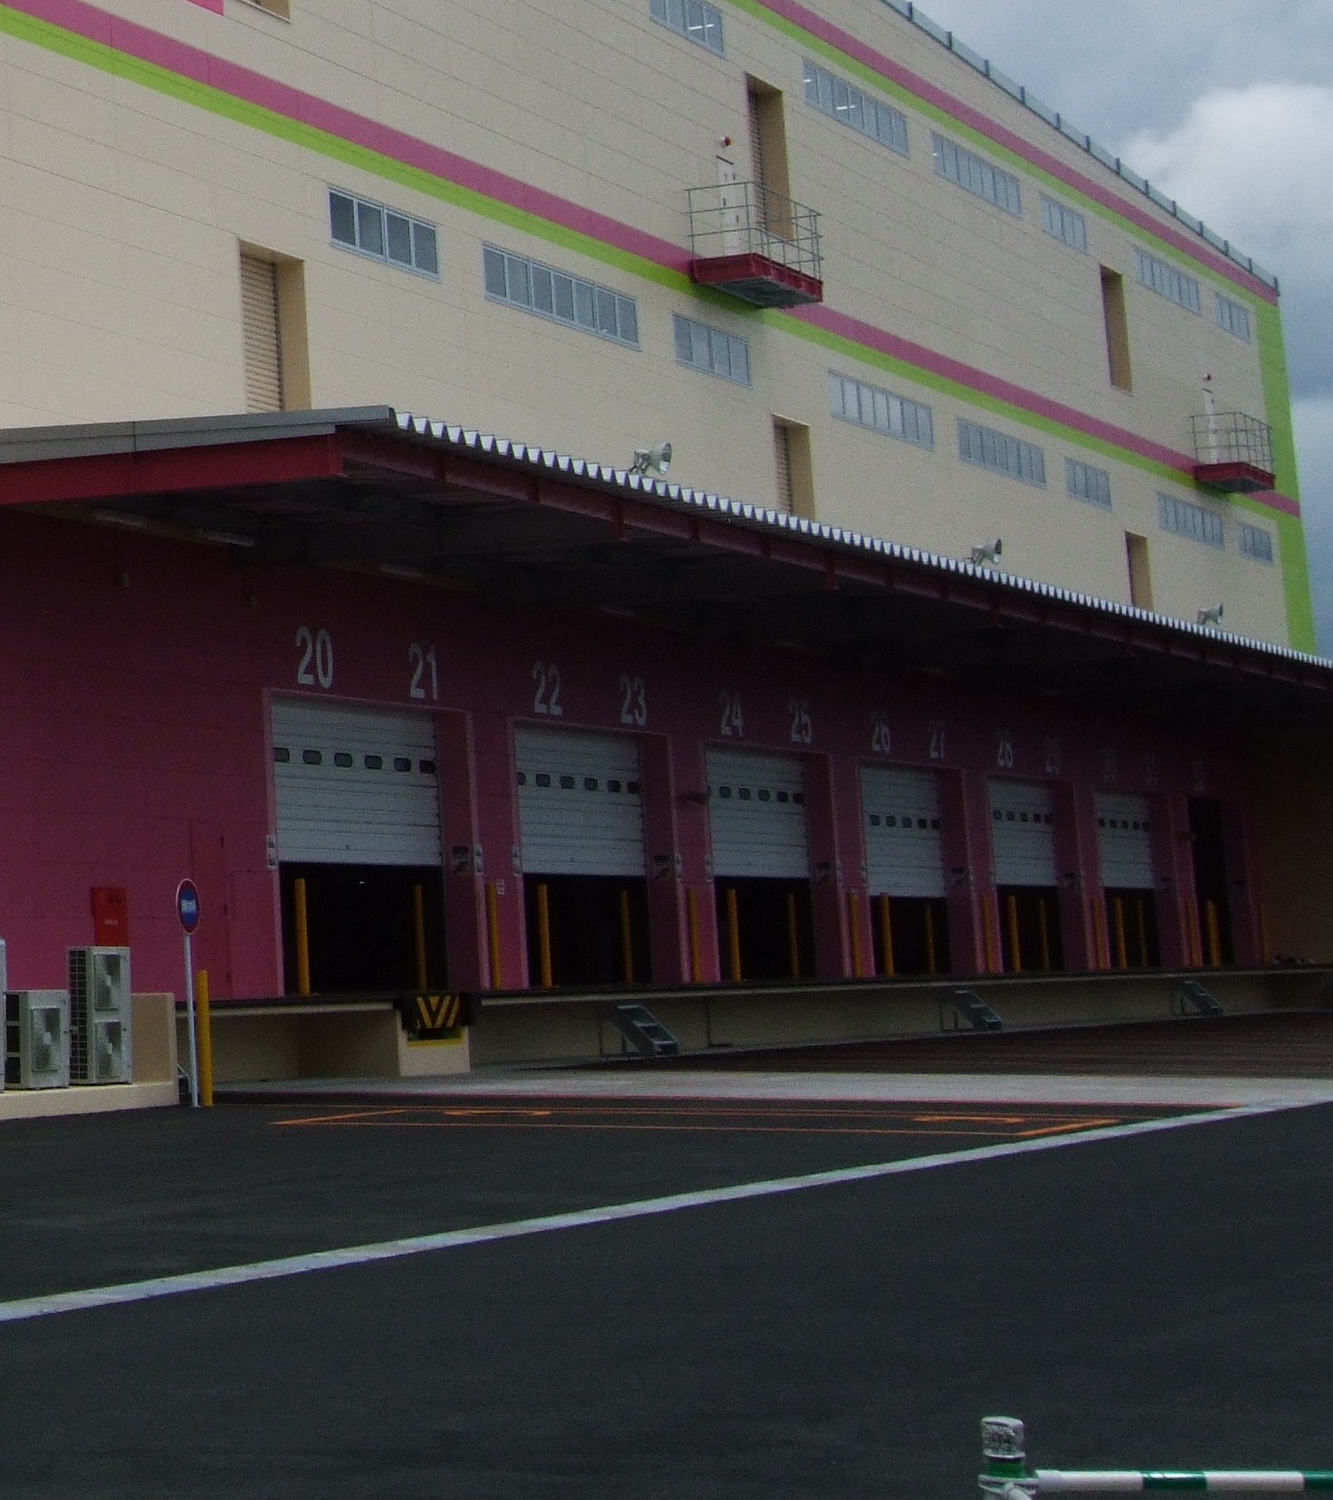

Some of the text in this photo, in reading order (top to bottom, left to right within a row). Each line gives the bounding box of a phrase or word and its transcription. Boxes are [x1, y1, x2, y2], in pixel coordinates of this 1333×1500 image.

[295, 625, 333, 689] 20
[408, 643, 438, 700] 21
[532, 661, 563, 716] 22
[619, 674, 647, 726] 23
[719, 687, 744, 737] 24
[788, 696, 812, 745] 25
[870, 709, 891, 754] 26
[927, 717, 946, 760] 27
